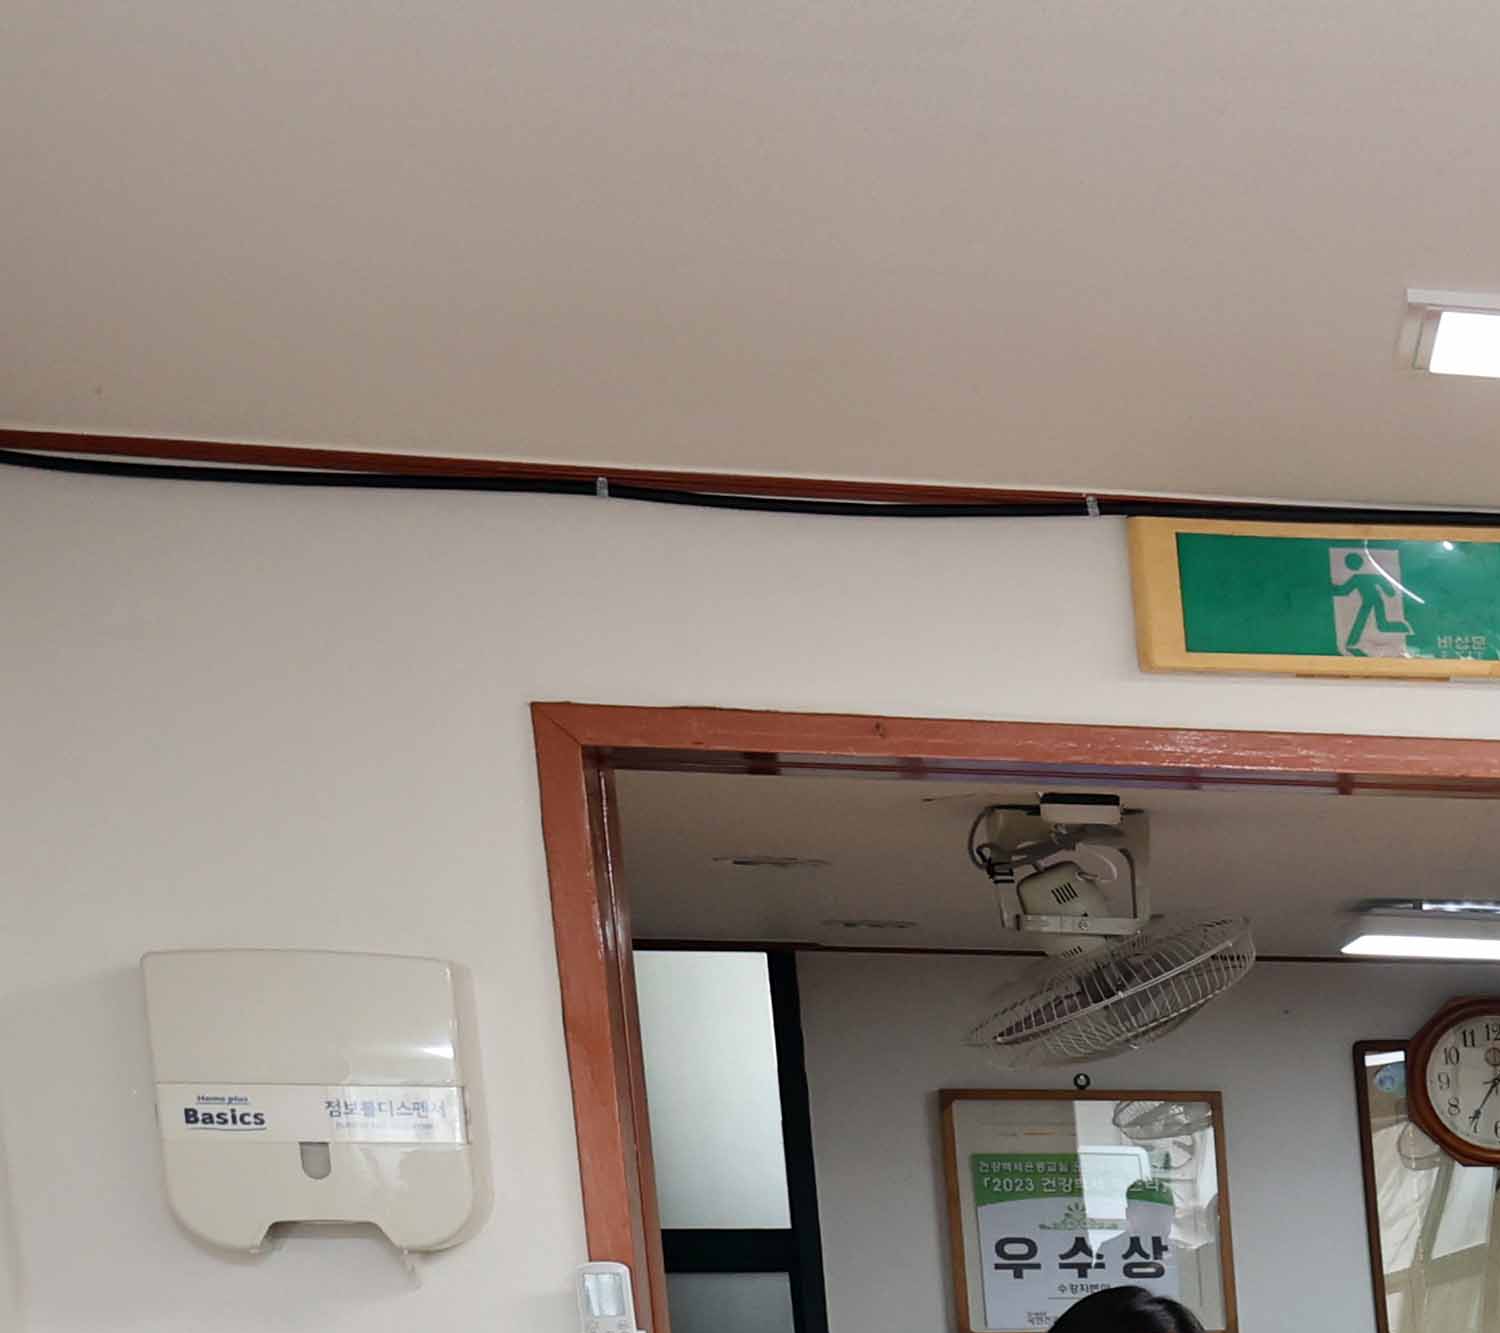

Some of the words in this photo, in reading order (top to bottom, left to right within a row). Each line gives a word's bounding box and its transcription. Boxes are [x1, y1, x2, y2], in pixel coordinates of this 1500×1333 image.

[1438, 635, 1486, 650] 비상문
[1462, 1029, 1475, 1047] 11
[1443, 1047, 1460, 1065] 10
[1438, 1072, 1450, 1090] 9
[1448, 1097, 1460, 1115] 8
[184, 1107, 266, 1125] Basics
